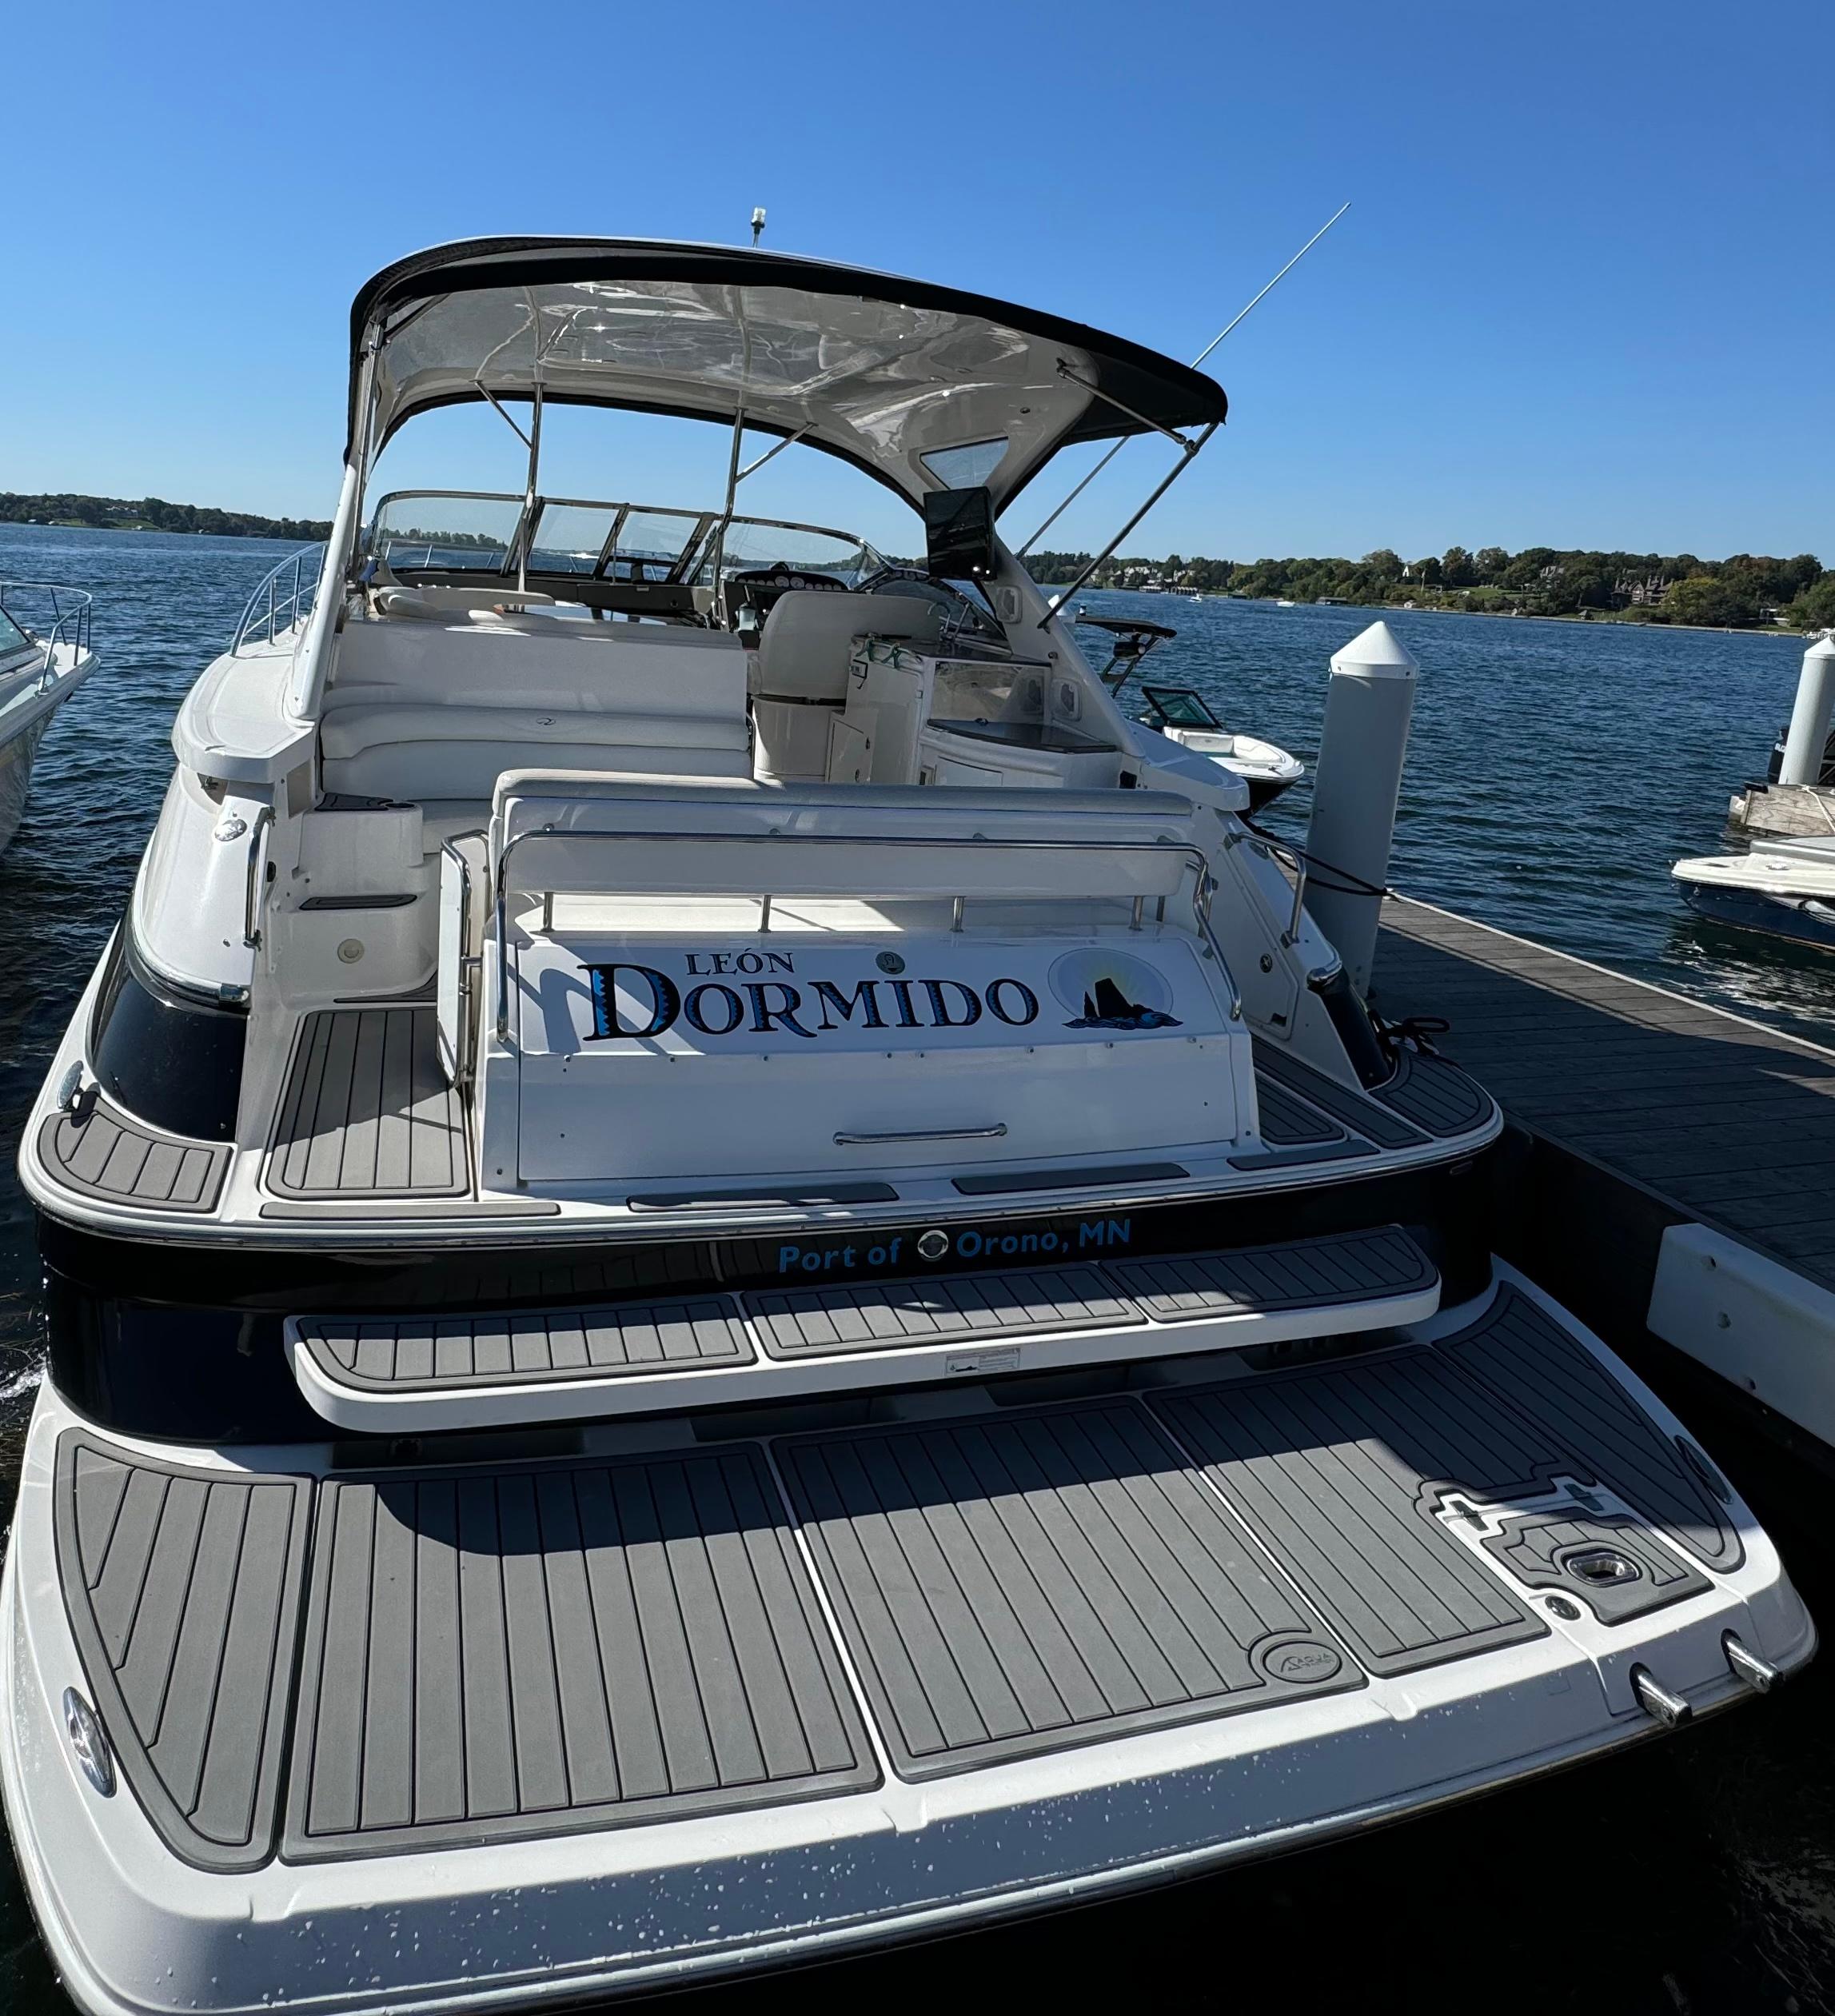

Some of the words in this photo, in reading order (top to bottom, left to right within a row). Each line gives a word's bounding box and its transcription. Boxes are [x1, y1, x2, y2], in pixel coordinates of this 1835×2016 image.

[684, 947, 795, 976] LEÓN
[576, 963, 1039, 1042] DORMIDO
[778, 1245, 856, 1273] Port
[868, 1237, 902, 1265] of
[957, 1231, 1068, 1258] Orono,
[1078, 1219, 1131, 1248] MN
